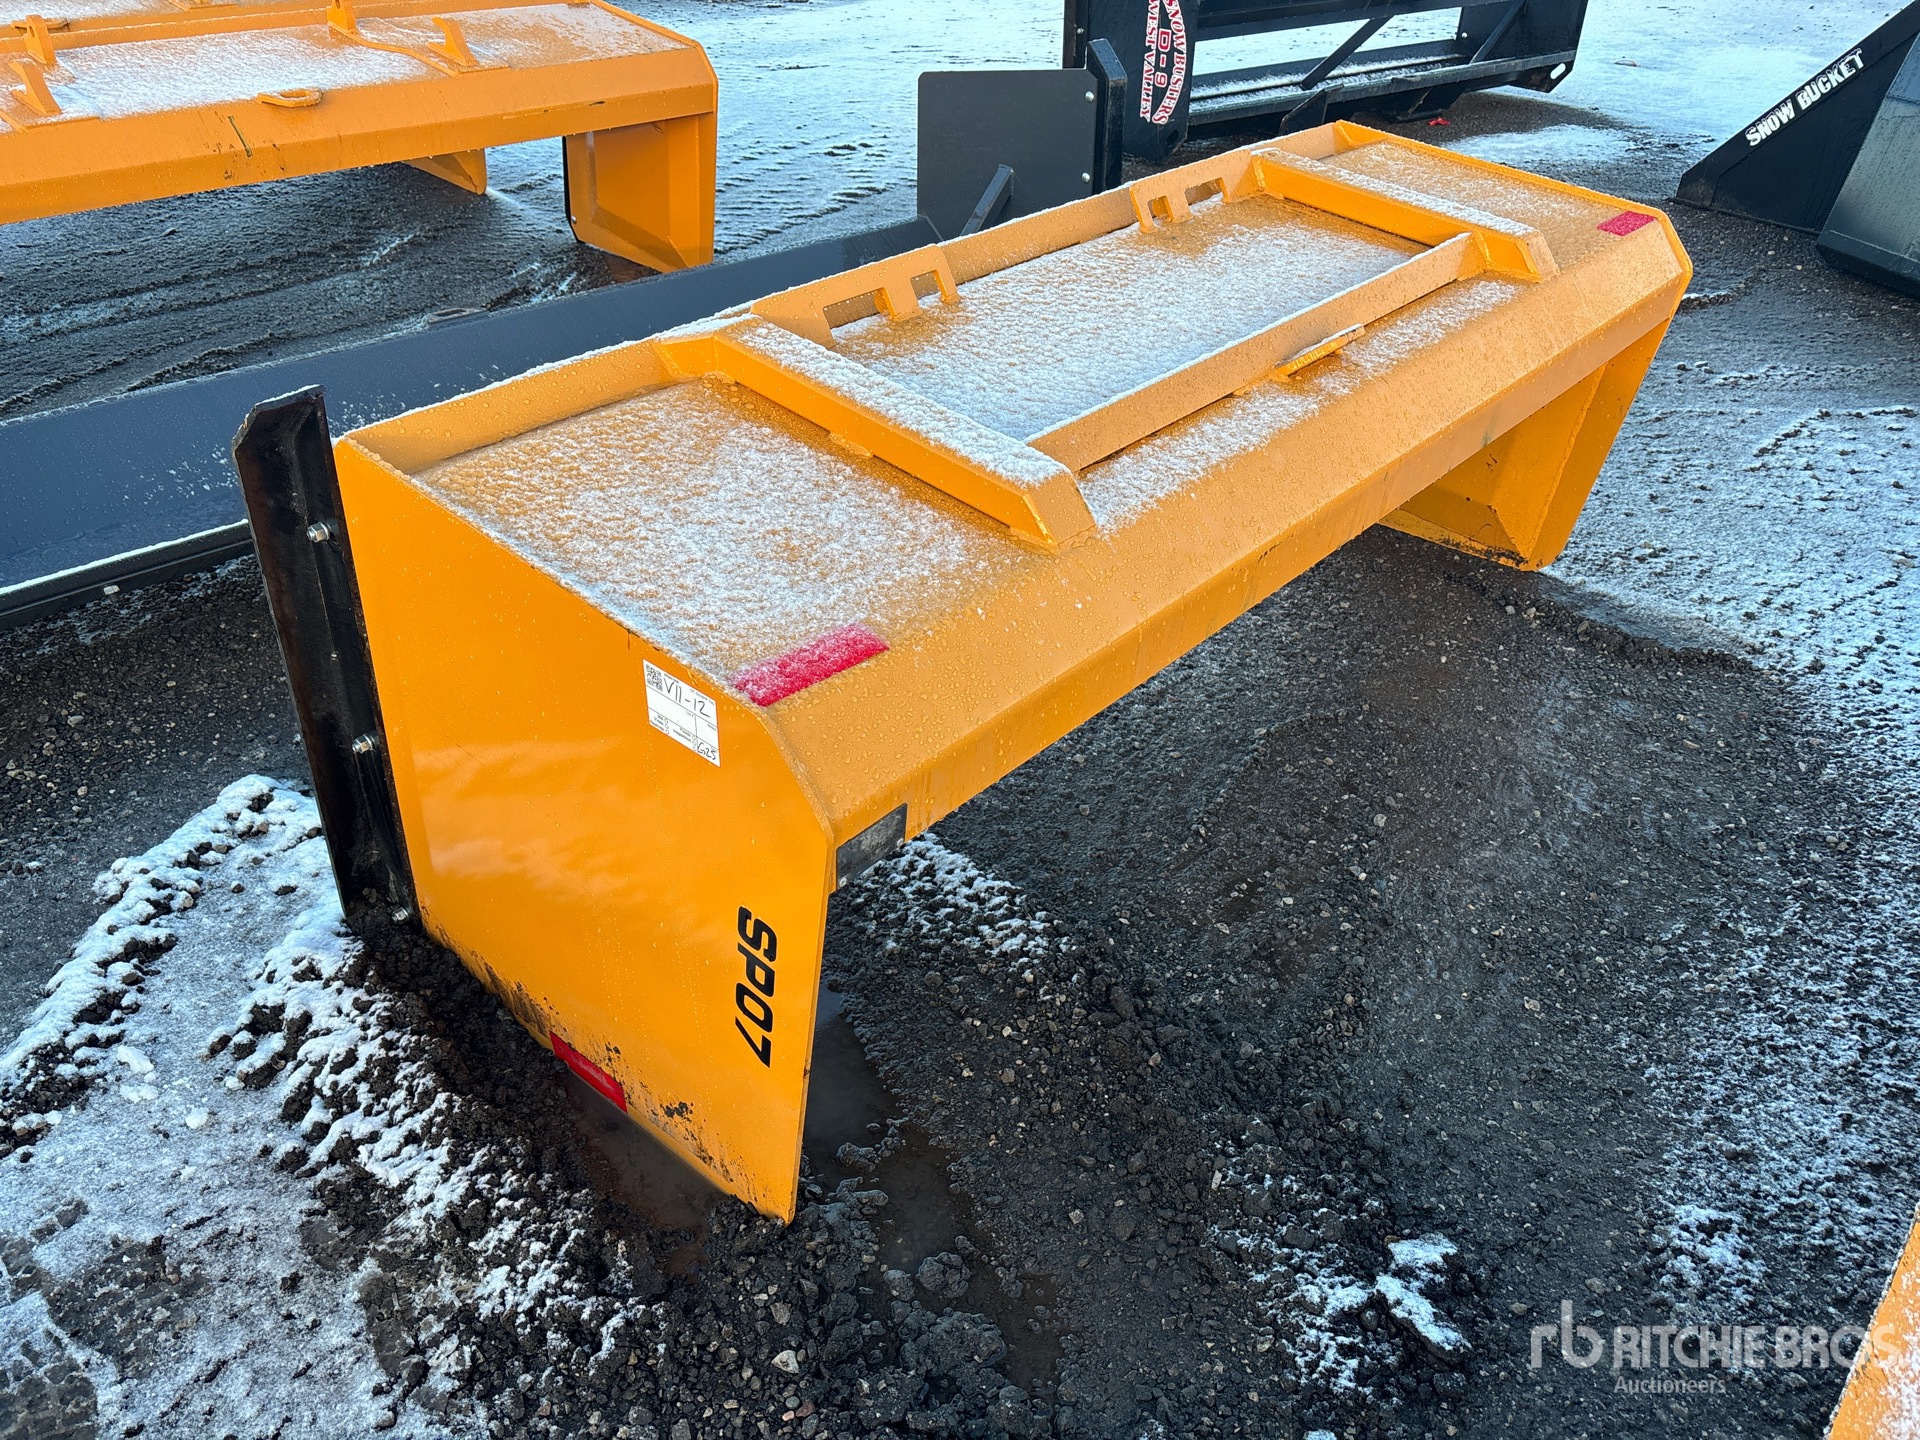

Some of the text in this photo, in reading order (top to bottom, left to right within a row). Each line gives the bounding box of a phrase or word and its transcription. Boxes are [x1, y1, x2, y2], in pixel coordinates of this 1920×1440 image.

[1140, 0, 1160, 122] WEST VALLEY
[1152, 0, 1187, 124] SNOW BUSTERS
[1154, 28, 1172, 88] D-9
[1745, 48, 1865, 146] SNOW BUCKET
[735, 905, 778, 1068] SP07
